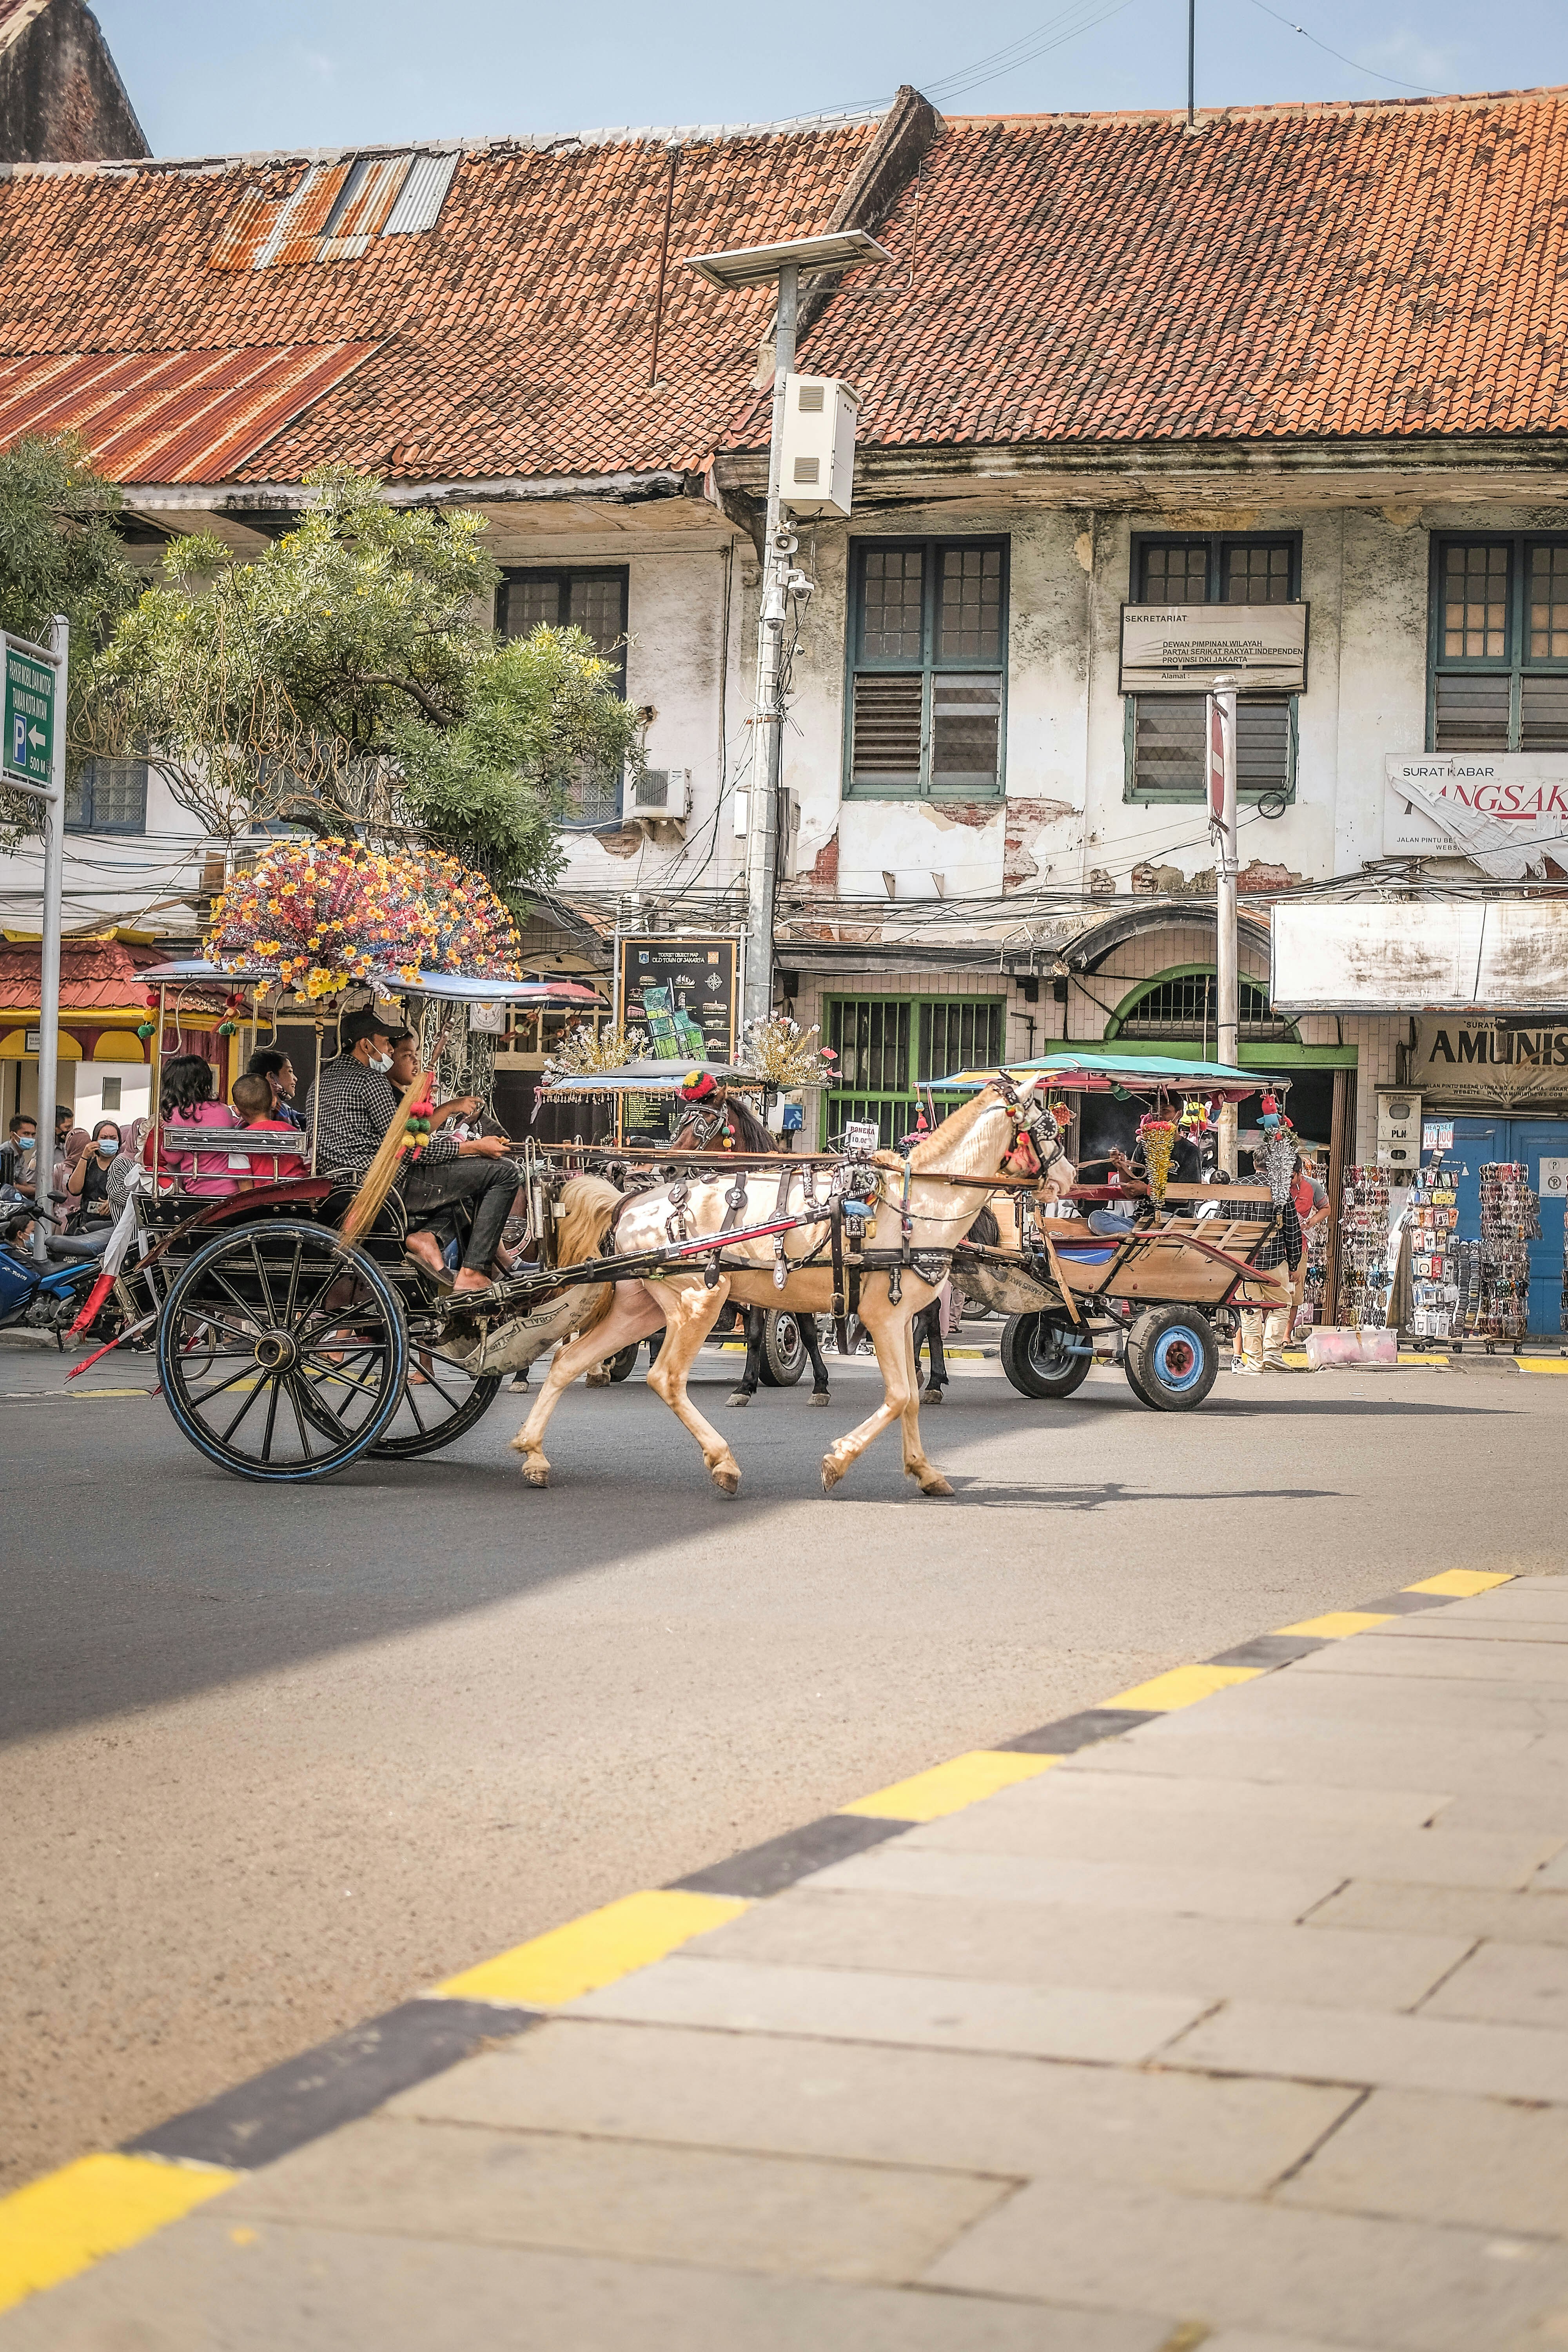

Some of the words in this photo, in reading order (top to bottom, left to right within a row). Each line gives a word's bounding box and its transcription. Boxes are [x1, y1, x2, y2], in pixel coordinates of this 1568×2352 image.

[9, 659, 22, 684] PARKIR
[21, 664, 32, 689] MOBIL
[39, 673, 51, 697] MOTOR
[13, 687, 26, 712] TAMAN
[25, 693, 36, 717] KOTA
[36, 698, 47, 721] INTAN
[15, 719, 25, 758] P
[30, 756, 40, 771] 500
[40, 760, 46, 774] M
[1403, 767, 1445, 777] SURAT
[850, 1126, 875, 1135] BONEKA
[1392, 1130, 1406, 1138] PLN
